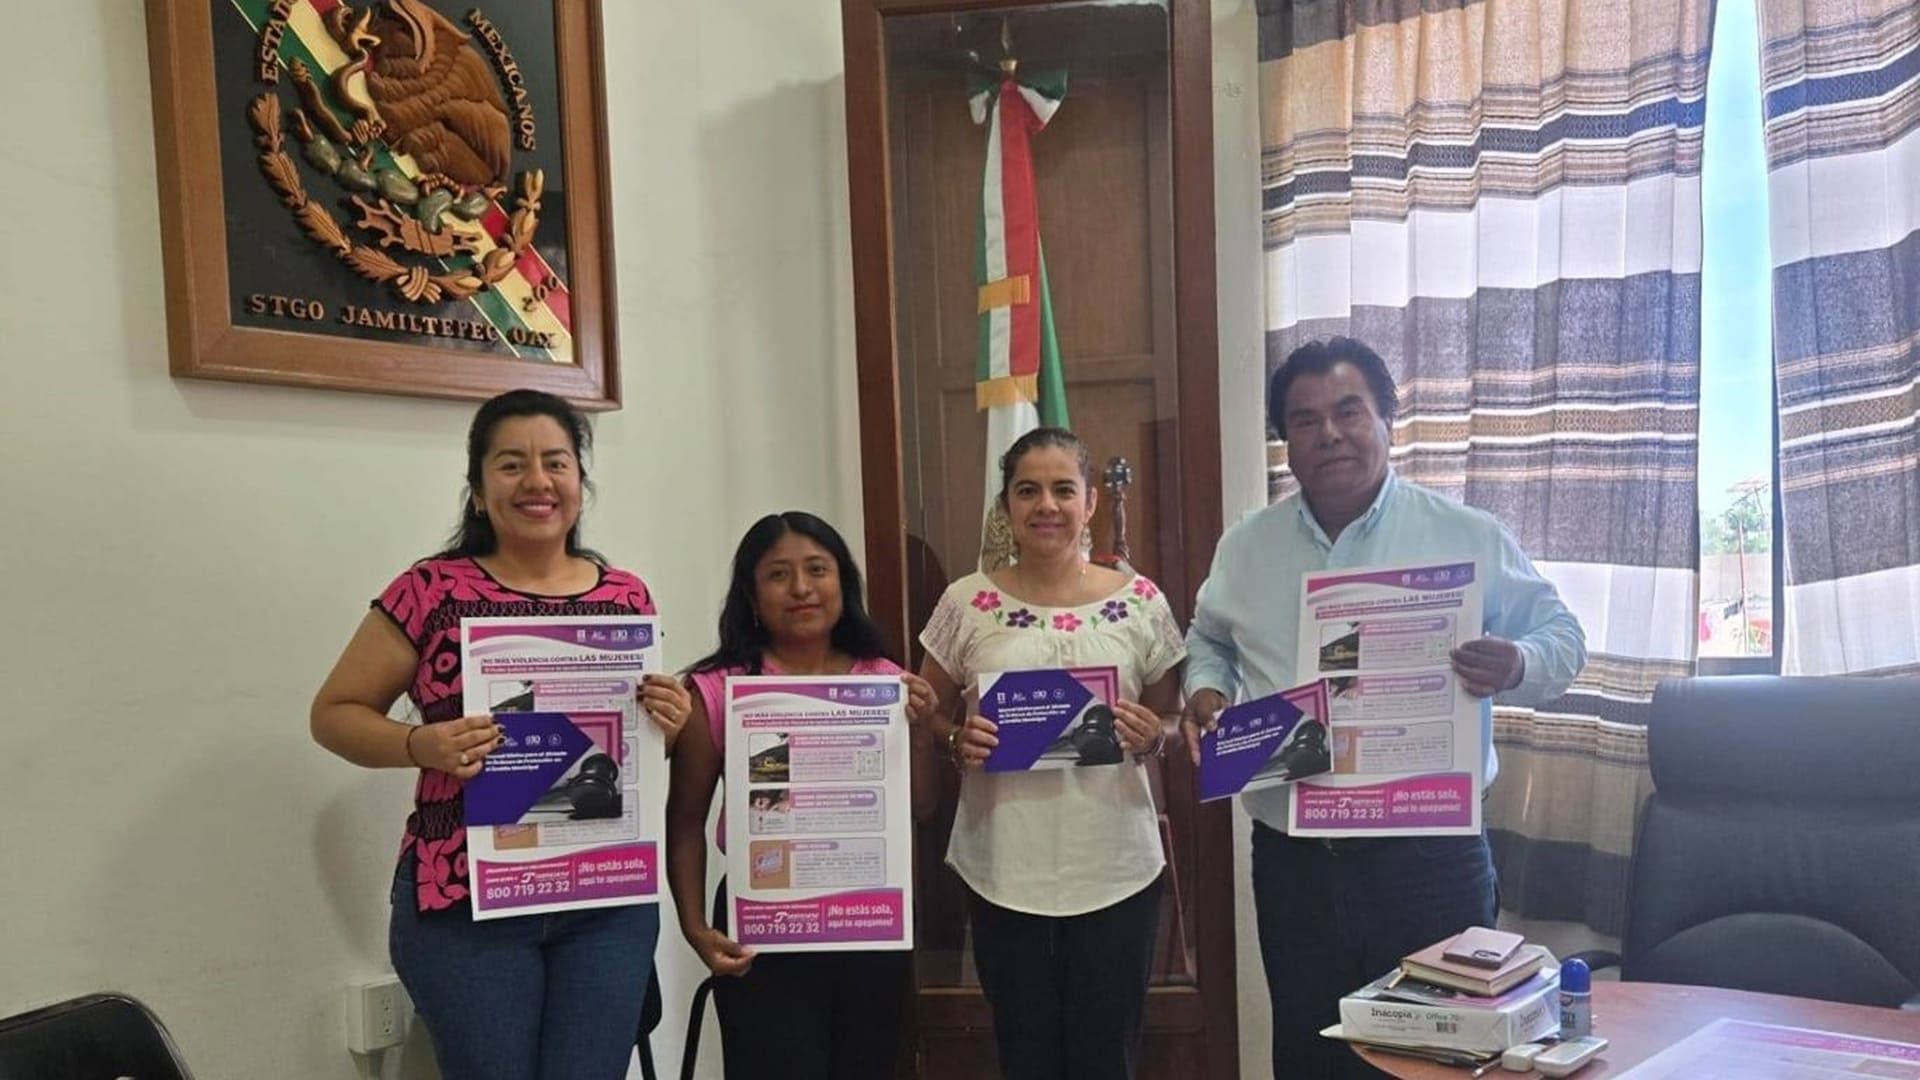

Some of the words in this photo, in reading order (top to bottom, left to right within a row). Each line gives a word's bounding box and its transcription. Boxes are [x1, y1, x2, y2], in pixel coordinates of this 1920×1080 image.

[470, 8, 536, 151] MEXICANOS
[250, 294, 325, 320] STGO
[342, 305, 499, 341] JAMILTEPEC
[513, 326, 558, 349] OAX
[579, 654, 596, 662] LAS
[1304, 808, 1327, 819] 800
[1330, 808, 1350, 819] 719
[1352, 808, 1367, 819] 22
[1369, 808, 1384, 819] 32
[578, 862, 595, 874] ¡No
[597, 860, 622, 872] estás
[623, 858, 647, 870] sola,
[486, 886, 511, 900] 800
[513, 883, 535, 896] 719
[537, 882, 553, 894] 22
[554, 880, 570, 893] 32
[827, 905, 844, 916] ¡No
[845, 904, 870, 915] estás
[871, 903, 893, 915] sola,
[744, 924, 765, 935] 800
[767, 923, 786, 934] 719
[789, 923, 803, 933] 22
[806, 922, 820, 933] 32
[1371, 1007, 1413, 1019] Inacopia
